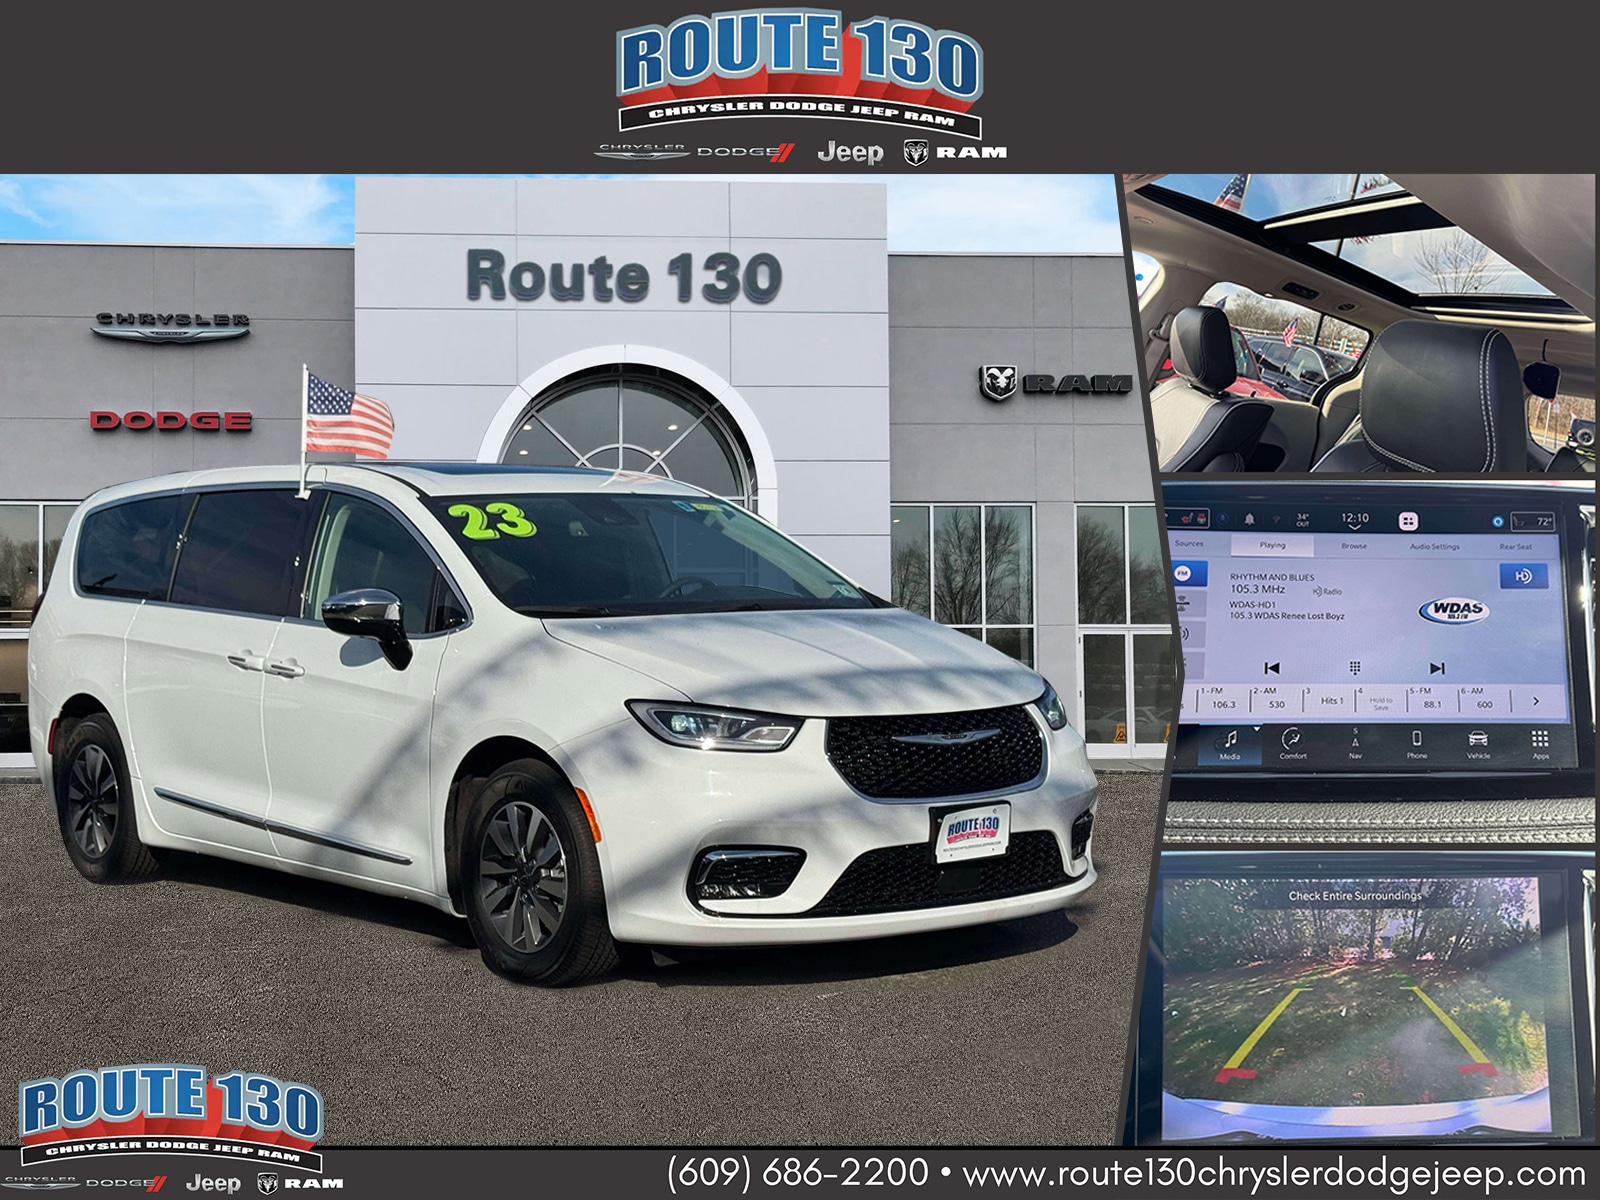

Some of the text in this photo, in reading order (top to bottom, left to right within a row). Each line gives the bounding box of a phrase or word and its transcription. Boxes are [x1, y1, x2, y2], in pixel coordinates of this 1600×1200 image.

[466, 248, 783, 304] Route 130
[96, 312, 250, 326] CHRYSLER
[1022, 374, 1133, 394] RAM
[89, 410, 252, 431] DODGE
[447, 502, 538, 540] 23
[1341, 512, 1370, 523] 12:10
[1175, 539, 1204, 548] Sources
[1260, 541, 1287, 550] Playing
[1341, 542, 1367, 550] Browse
[1410, 543, 1460, 551] Audio Settings
[1230, 572, 1315, 582] RHYTHM AND BLUES
[1231, 583, 1286, 595] 105.3 MHz
[1323, 587, 1342, 596] Radio
[1229, 600, 1276, 609] WDAS-HD1
[1433, 602, 1484, 614] WDAS
[1230, 611, 1345, 622] 105.3 WDAS Renee Lost Boyz
[1212, 700, 1237, 709] 106.3
[1269, 701, 1286, 709] 530
[1321, 697, 1338, 705] Hits
[1423, 701, 1442, 709] 88.1
[1477, 701, 1494, 709] 600
[1219, 752, 1241, 761] Media
[1279, 752, 1308, 760] Comfort
[1349, 752, 1363, 760] Nav
[1406, 752, 1428, 760] Phone
[1467, 752, 1491, 760] Vehicle
[1533, 752, 1550, 762] Apps
[947, 816, 1000, 837] ROUTE 130
[1288, 890, 1423, 902] Check Entire Surroundings
